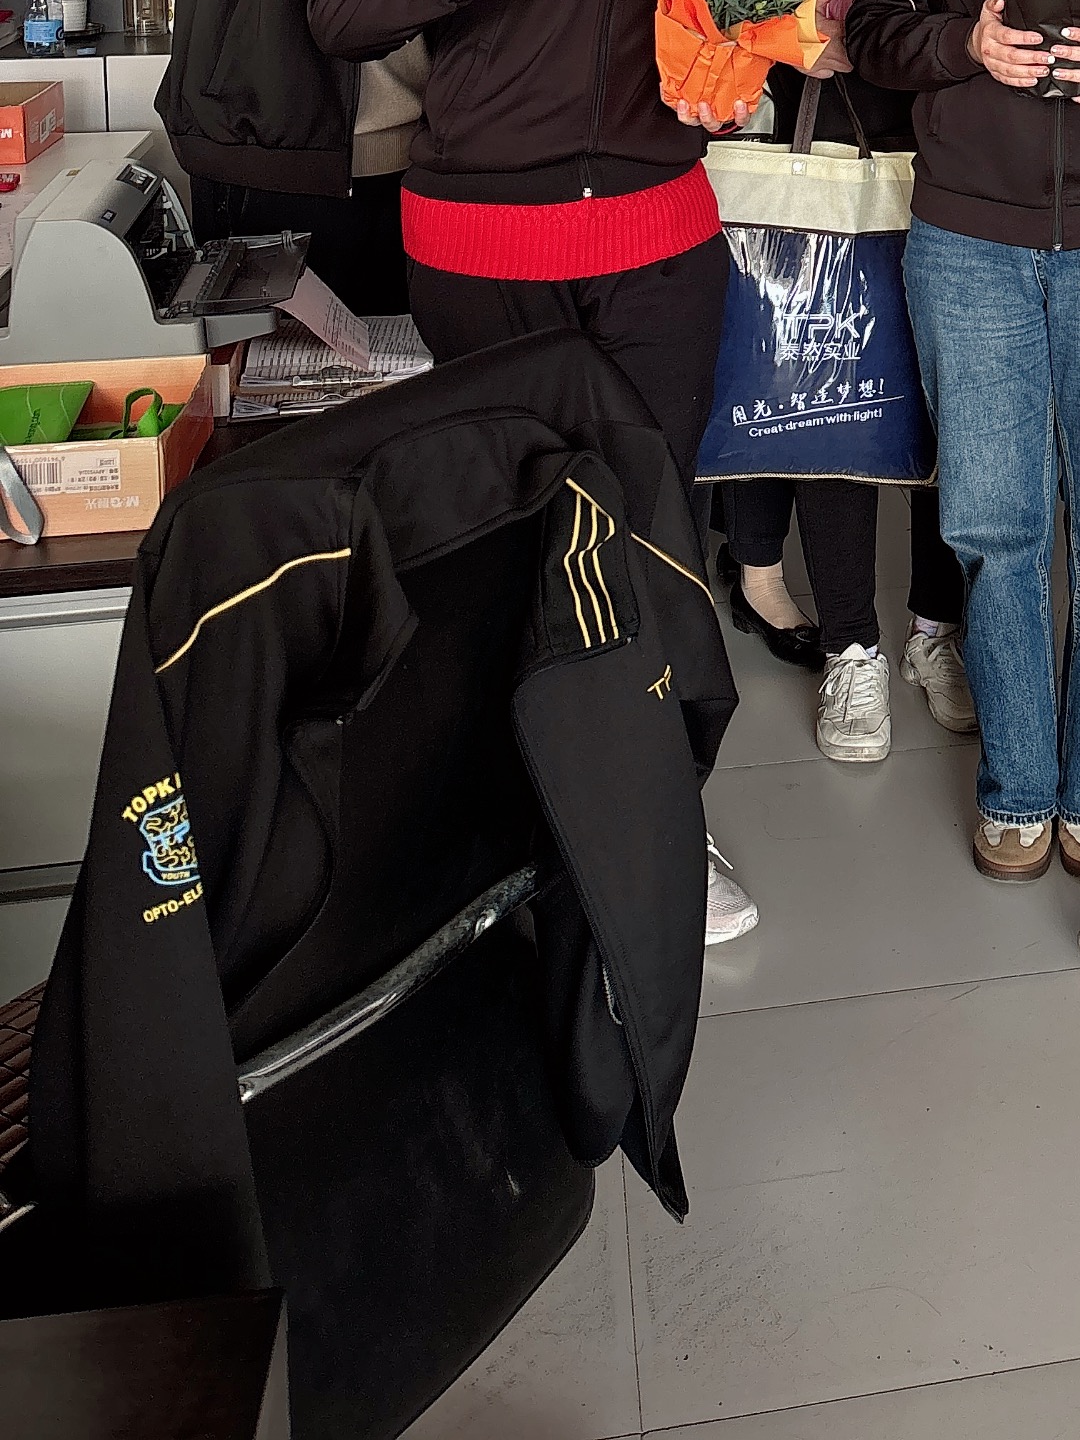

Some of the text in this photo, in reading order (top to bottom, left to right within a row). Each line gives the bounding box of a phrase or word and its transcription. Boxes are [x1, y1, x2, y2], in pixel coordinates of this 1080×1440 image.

[748, 424, 784, 438] Creat
[785, 416, 825, 432] dream
[825, 411, 853, 425] with
